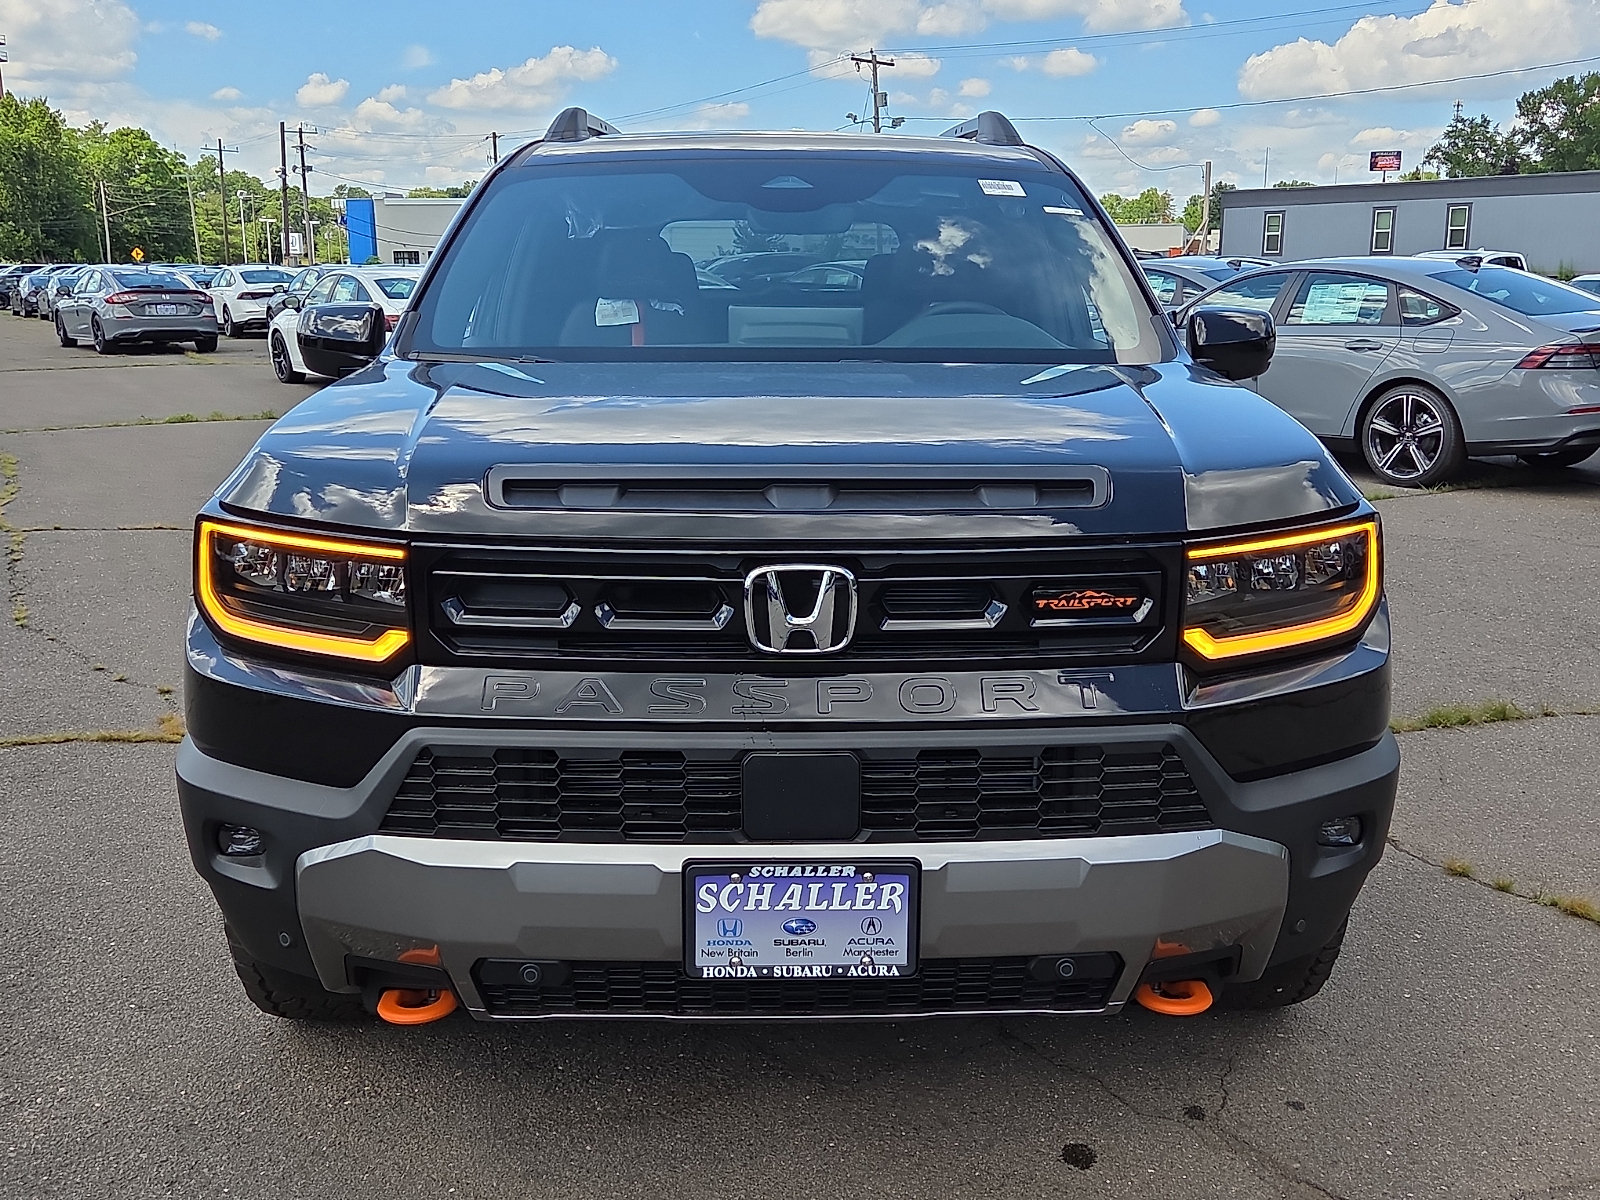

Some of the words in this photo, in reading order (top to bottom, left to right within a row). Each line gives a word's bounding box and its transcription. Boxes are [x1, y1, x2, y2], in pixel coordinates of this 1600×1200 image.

[1035, 597, 1138, 610] TRAILSPORT
[480, 671, 1115, 715] PASSPORT
[748, 865, 857, 878] SCHALLER
[696, 882, 905, 915] SCHALLER
[706, 939, 753, 947] HONDA
[773, 938, 825, 947] SUBARU
[847, 937, 895, 946] ACURA
[700, 948, 725, 958] New
[727, 947, 759, 958] Britain
[785, 947, 814, 958] Berlin
[842, 946, 900, 957] Manchester
[702, 965, 758, 978] HONDA
[773, 965, 833, 978] SUBARU
[846, 964, 901, 977] ACURA
